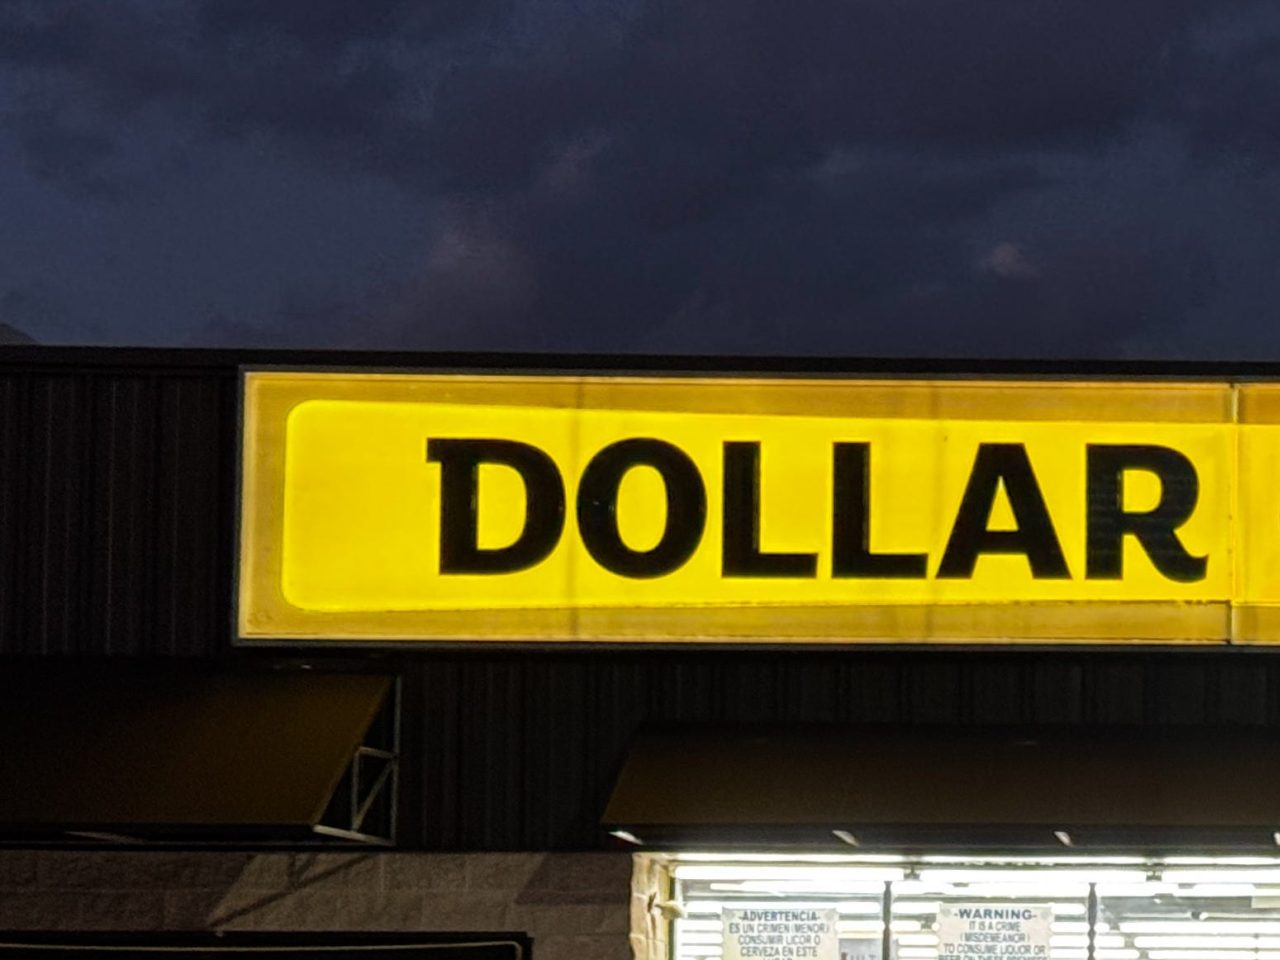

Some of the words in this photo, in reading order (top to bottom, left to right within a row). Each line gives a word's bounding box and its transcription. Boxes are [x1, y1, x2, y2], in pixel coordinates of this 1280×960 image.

[425, 437, 1209, 583] DOLLAR
[729, 923, 740, 933] ES
[743, 923, 754, 933] UN
[757, 923, 790, 933] CRIMEN
[969, 921, 976, 931] IT
[995, 922, 1021, 931] CRIME
[738, 935, 783, 945] CONSUMIR
[786, 935, 811, 945] LICOR
[740, 946, 780, 957] CERVEZA
[782, 946, 794, 957] EN
[796, 946, 818, 957] ESTE
[943, 943, 955, 954] TO
[957, 944, 998, 954] CONSUME
[1001, 945, 1031, 955] LIQUOR
[1034, 945, 1046, 955] OR
